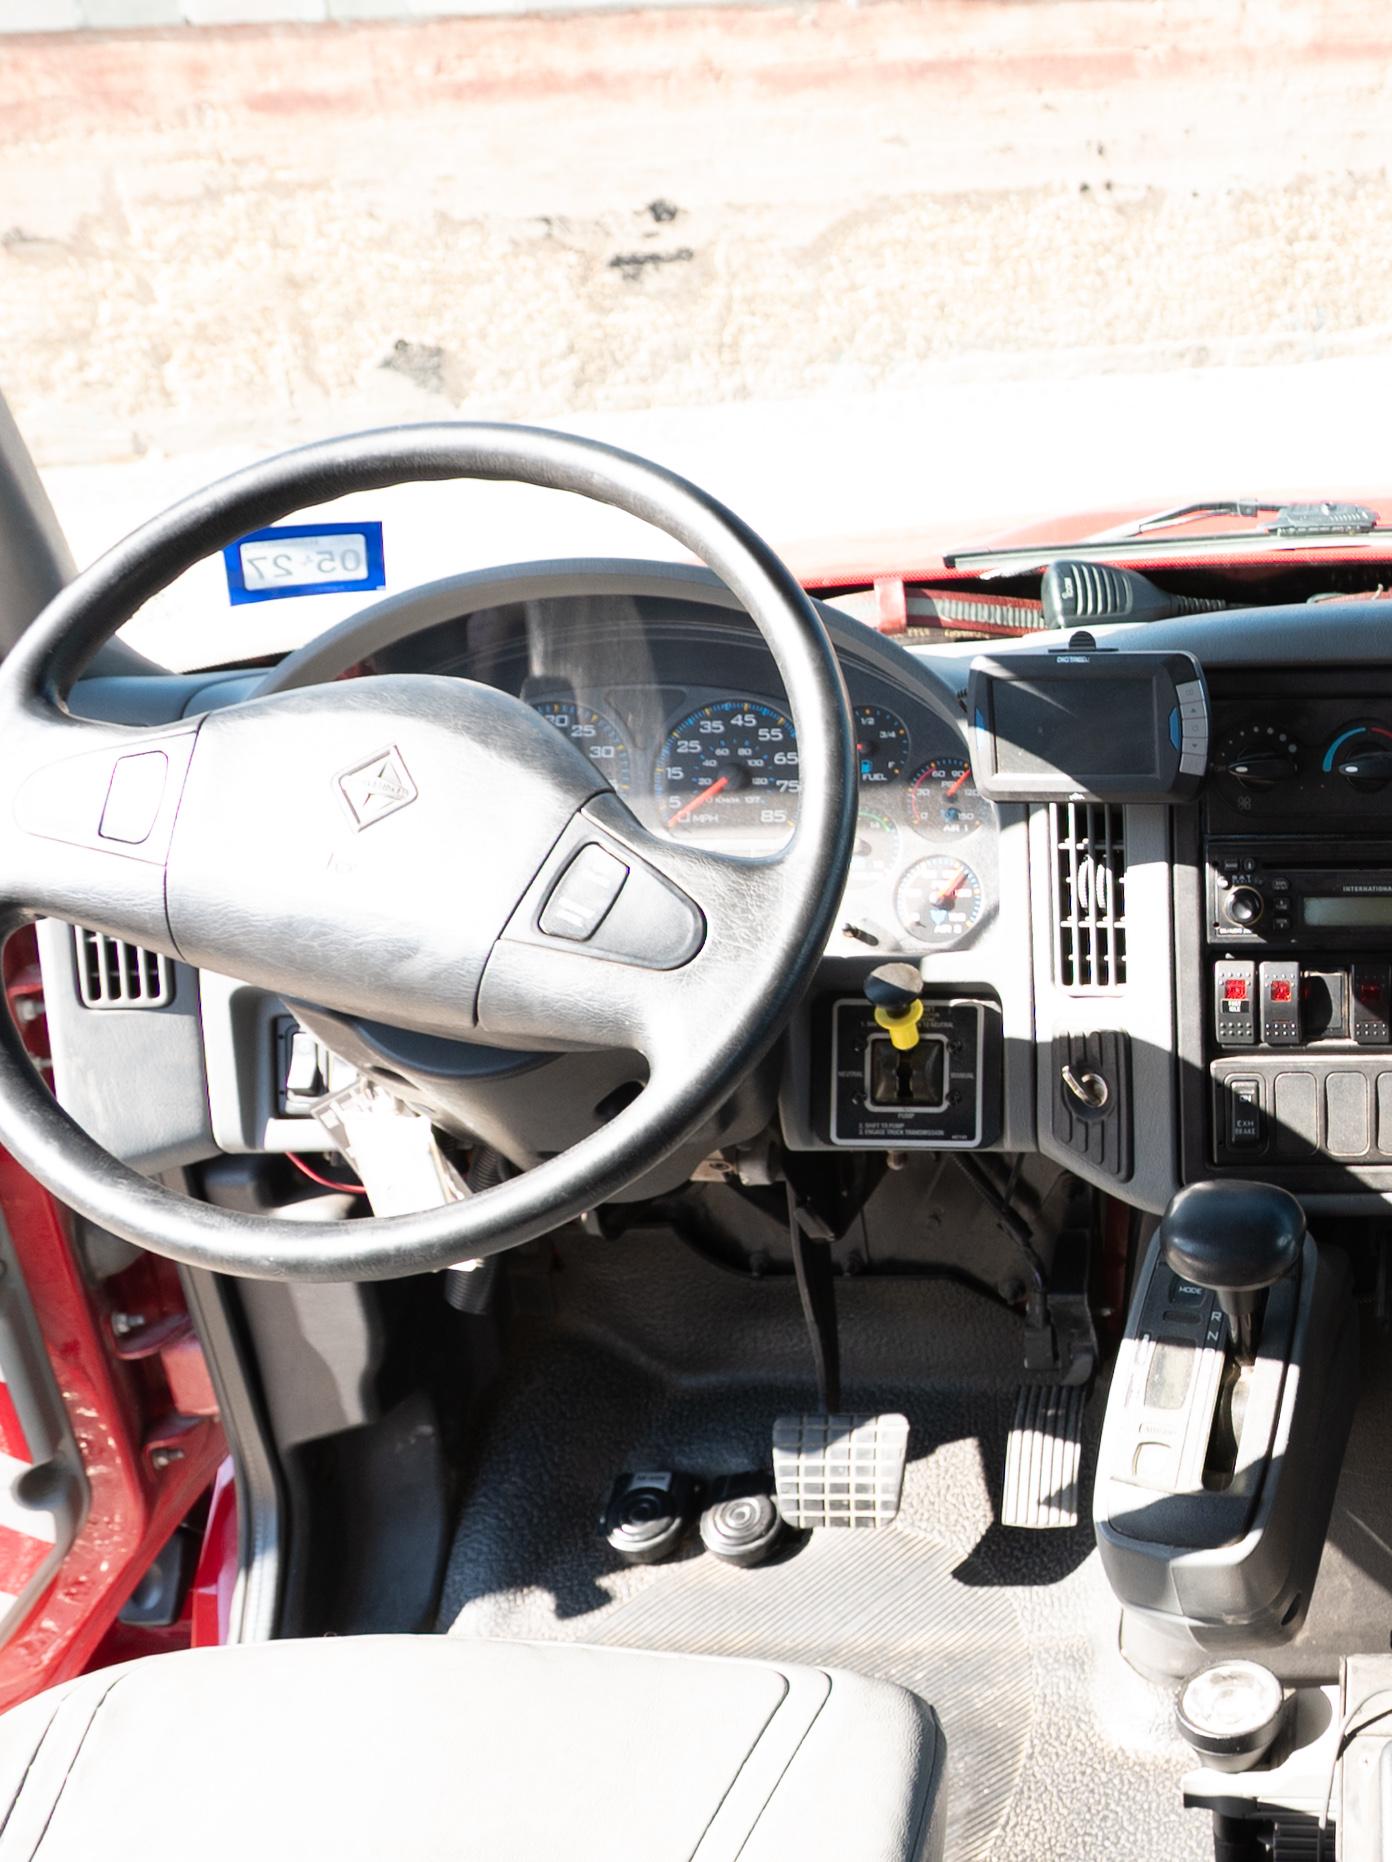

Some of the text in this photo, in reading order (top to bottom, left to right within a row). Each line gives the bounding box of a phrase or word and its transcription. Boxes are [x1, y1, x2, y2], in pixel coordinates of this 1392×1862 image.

[730, 714, 757, 727] 45
[571, 725, 596, 737] 25
[699, 720, 725, 734] 35
[757, 728, 783, 741] 55
[590, 746, 615, 758] 30
[676, 740, 702, 753] 25
[715, 748, 730, 756] 60
[737, 748, 752, 756] 80
[773, 752, 799, 765] 65
[665, 767, 684, 780] 15
[862, 773, 888, 781] FUEL
[931, 770, 946, 778] 60
[775, 780, 800, 793] 75
[669, 796, 682, 809] 5
[693, 813, 719, 823] MPH
[760, 810, 787, 823] 85
[1178, 1285, 1202, 1295] MODE
[1210, 1311, 1222, 1321] R
[1207, 1330, 1219, 1341] N
